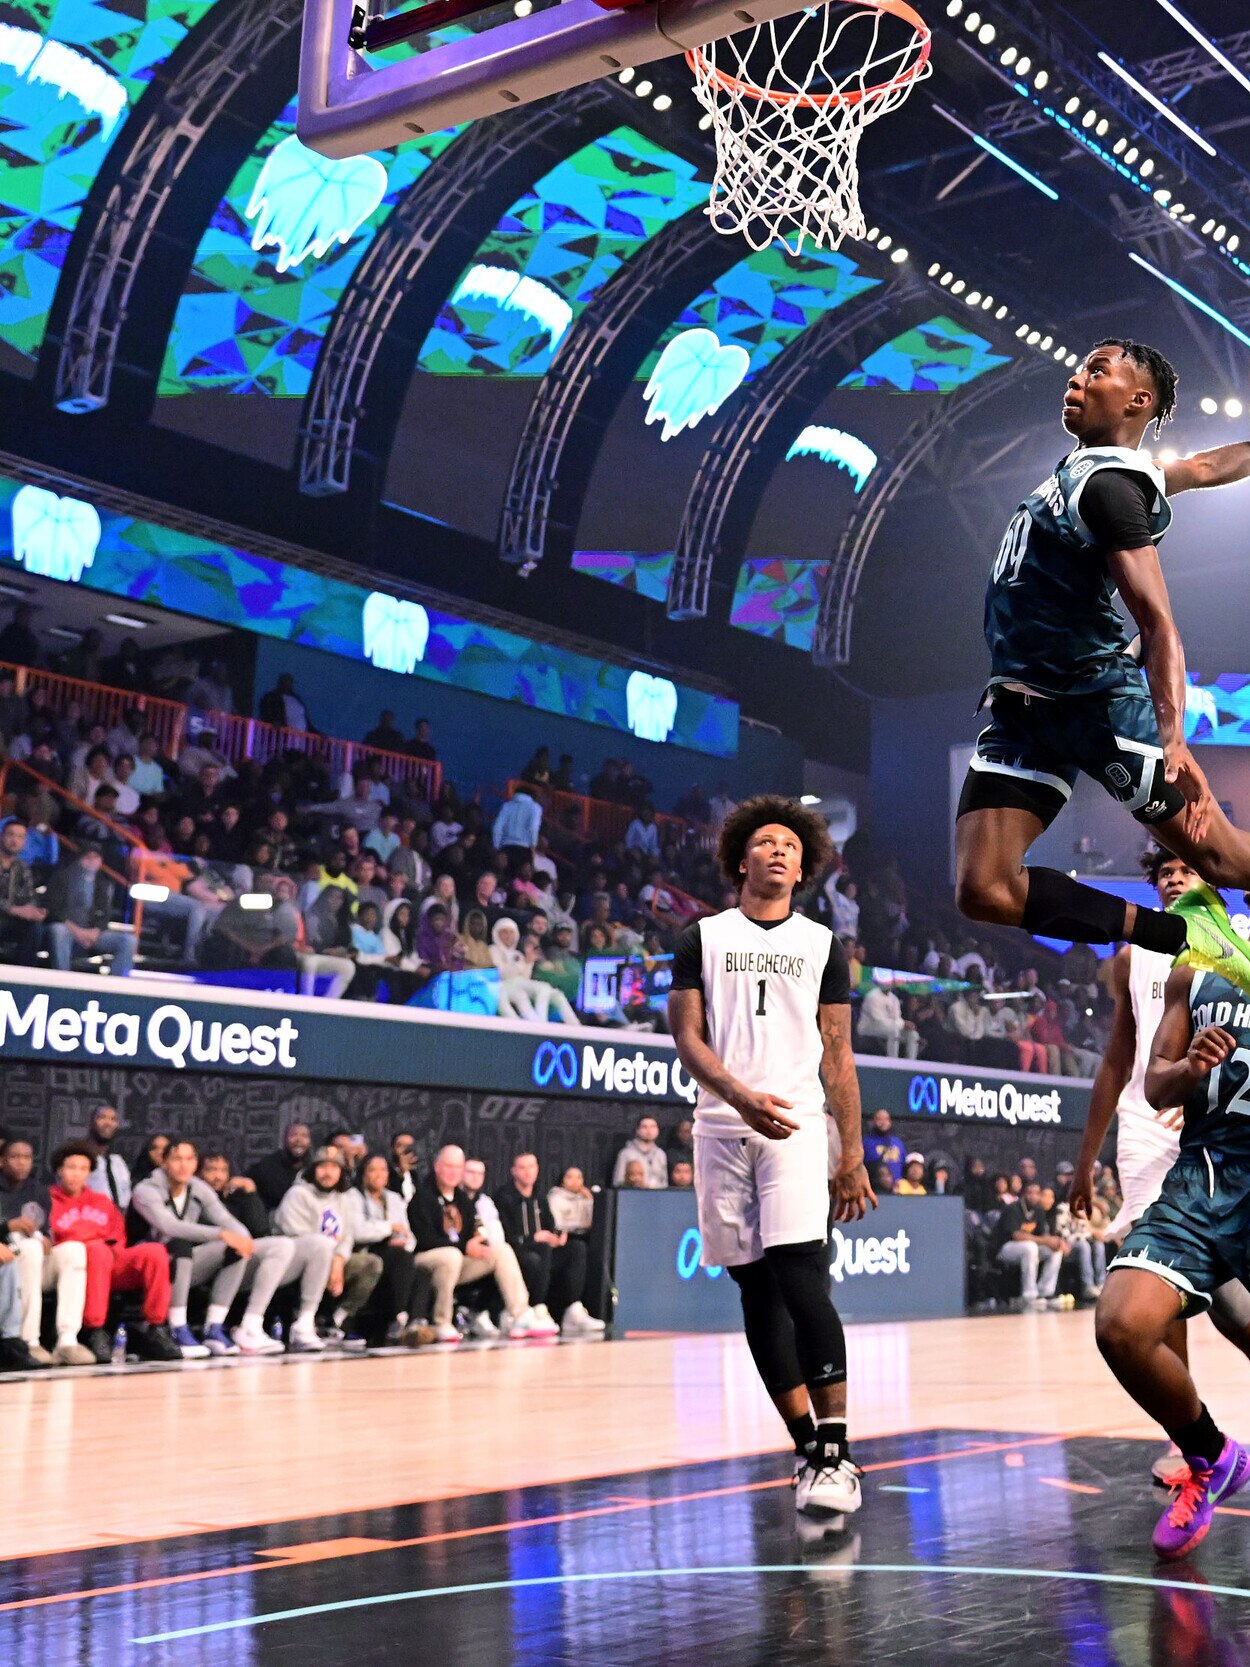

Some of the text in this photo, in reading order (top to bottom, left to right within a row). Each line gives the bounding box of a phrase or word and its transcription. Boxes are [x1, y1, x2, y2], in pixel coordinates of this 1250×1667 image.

[726, 952, 804, 978] BLUE CHECKS
[755, 979, 767, 1016] 1
[1151, 981, 1163, 999] BL
[0, 989, 299, 1068] Meta Quest
[581, 1045, 668, 1095] Meta
[940, 1078, 1061, 1125] Meta Quest
